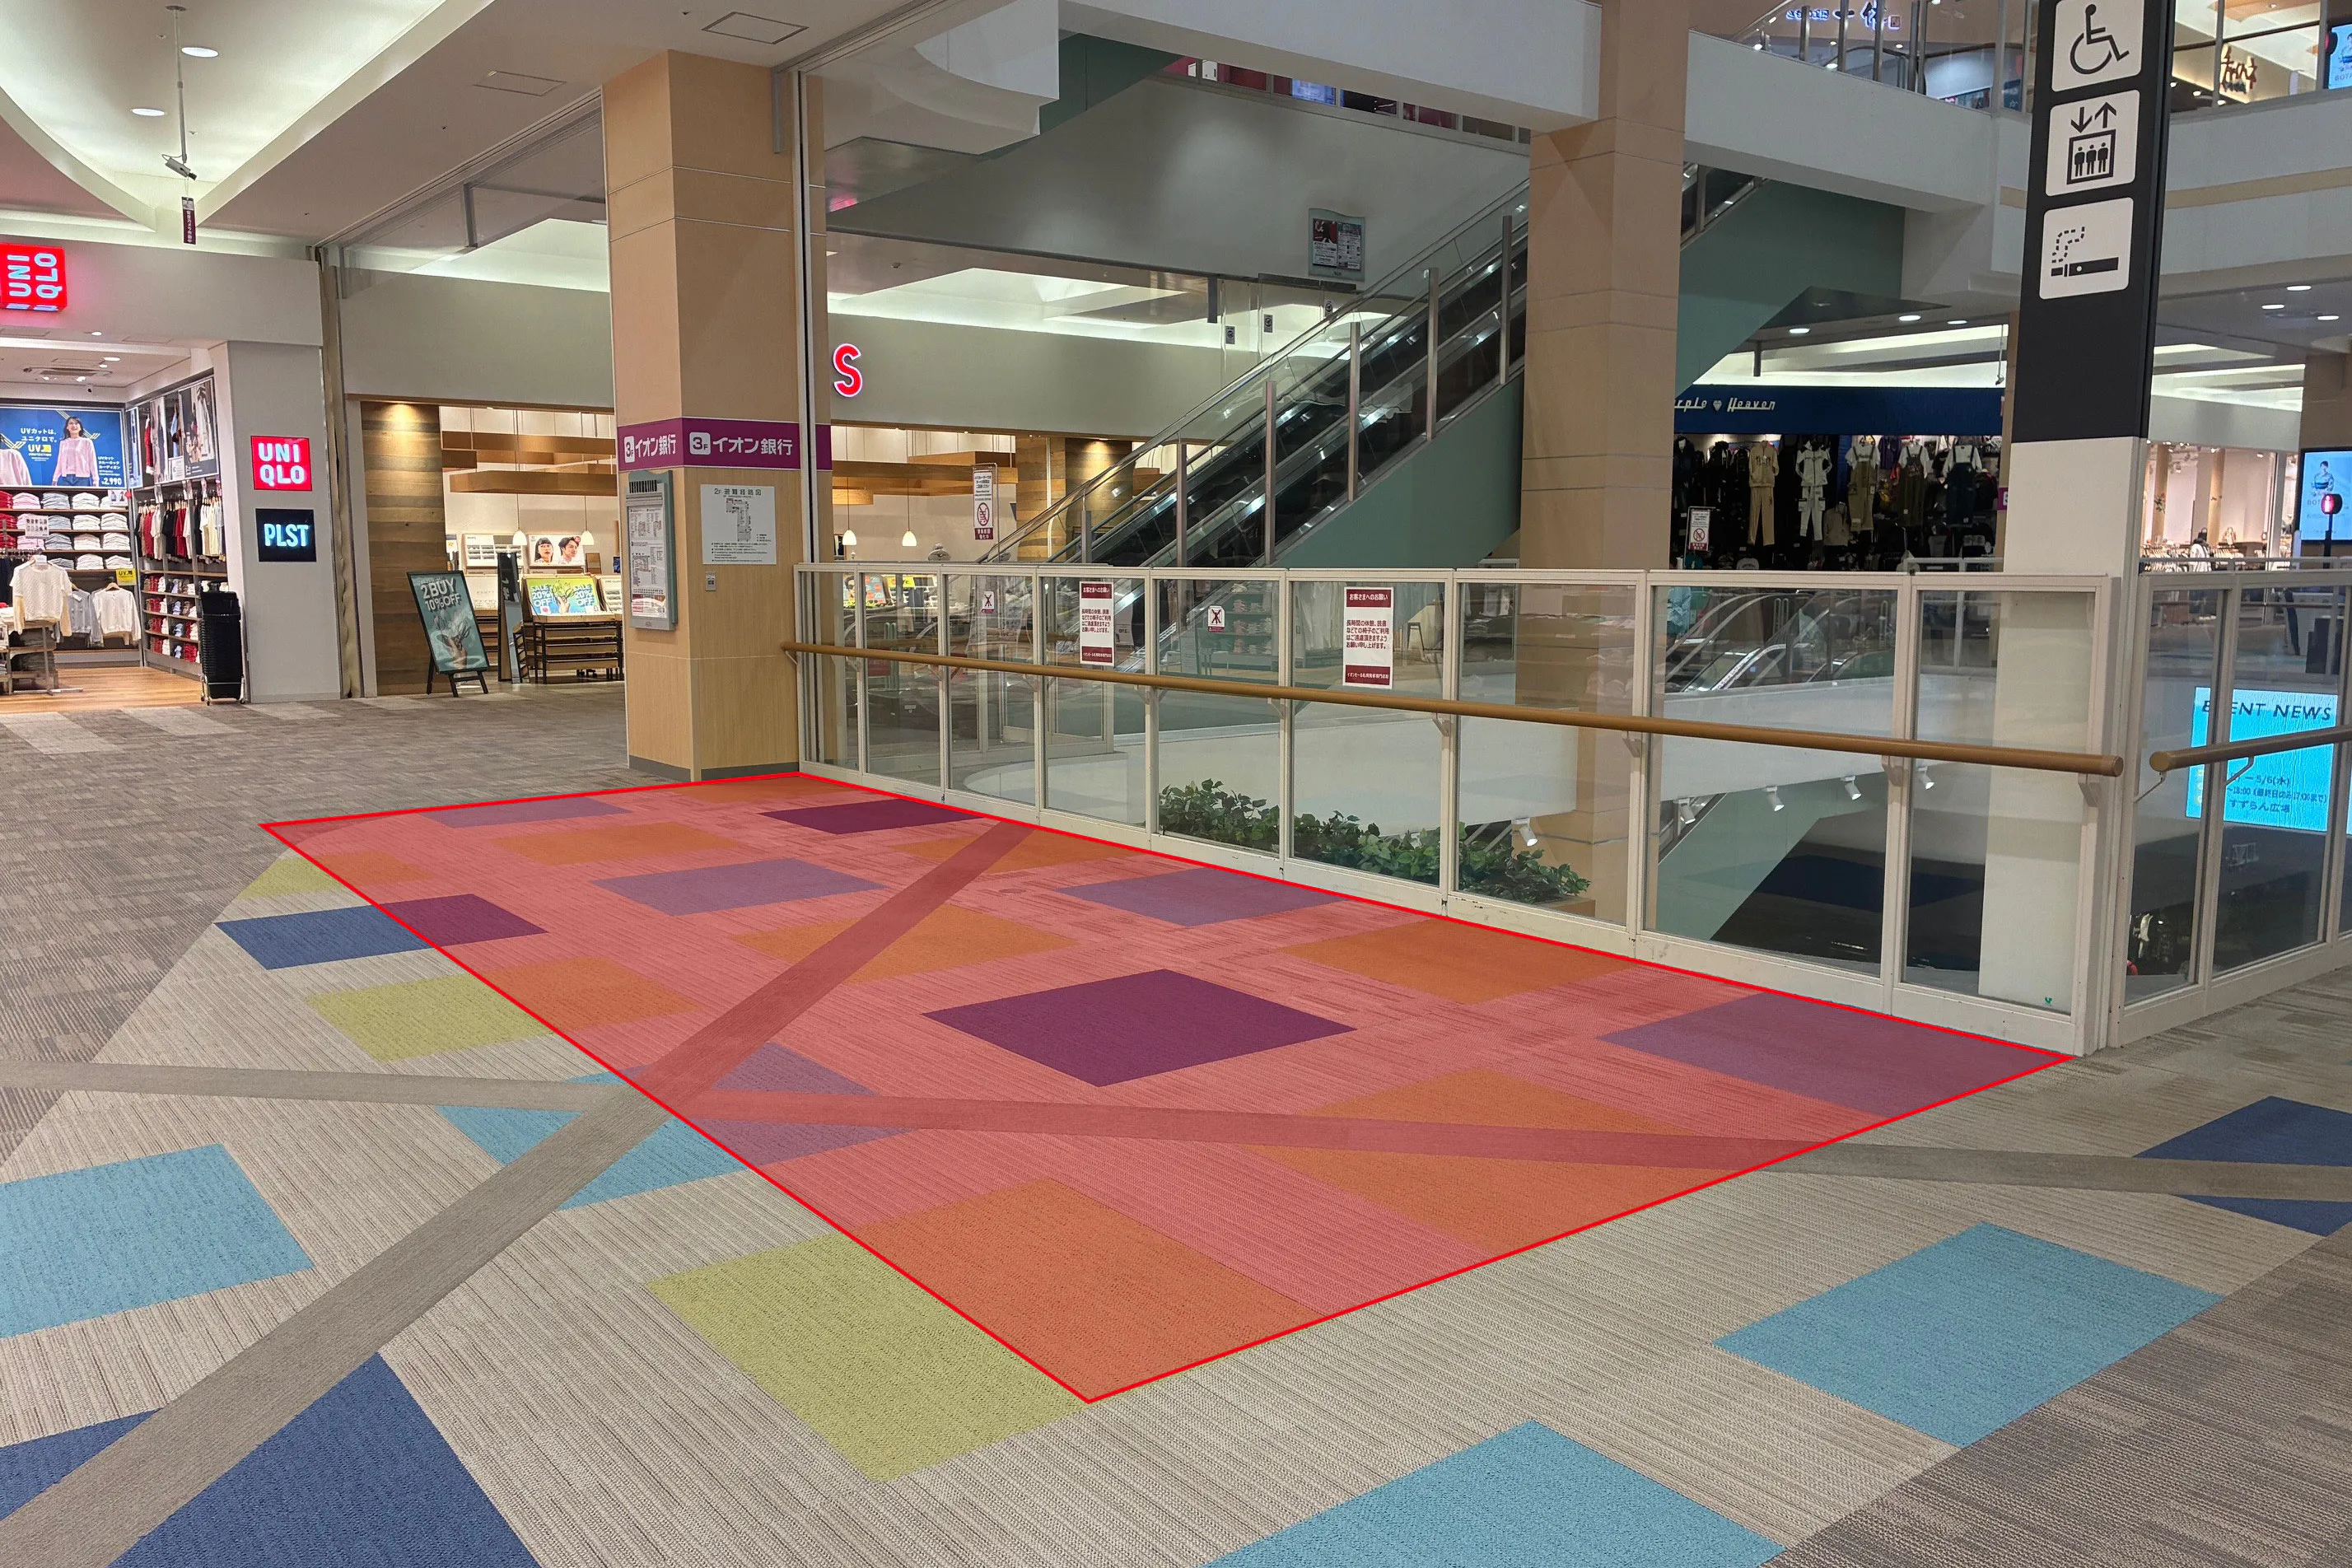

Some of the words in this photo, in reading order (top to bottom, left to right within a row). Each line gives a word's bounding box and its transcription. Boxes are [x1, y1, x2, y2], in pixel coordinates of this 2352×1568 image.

[7, 254, 32, 297] UNI
[34, 252, 63, 299] QLO
[833, 343, 862, 398] S
[1674, 397, 1707, 413] rple
[1727, 398, 1776, 413] Heaven
[258, 442, 301, 463] UNI
[635, 434, 676, 459] イオン銀行
[693, 436, 708, 450] 3F
[712, 437, 793, 456] イオン銀行
[259, 464, 305, 487] QLO
[264, 523, 309, 547] PLST
[532, 590, 551, 600] 20%
[534, 599, 552, 607] OFF
[1349, 593, 1388, 601] お客さまへのお願い
[2273, 704, 2331, 721] NEWS
